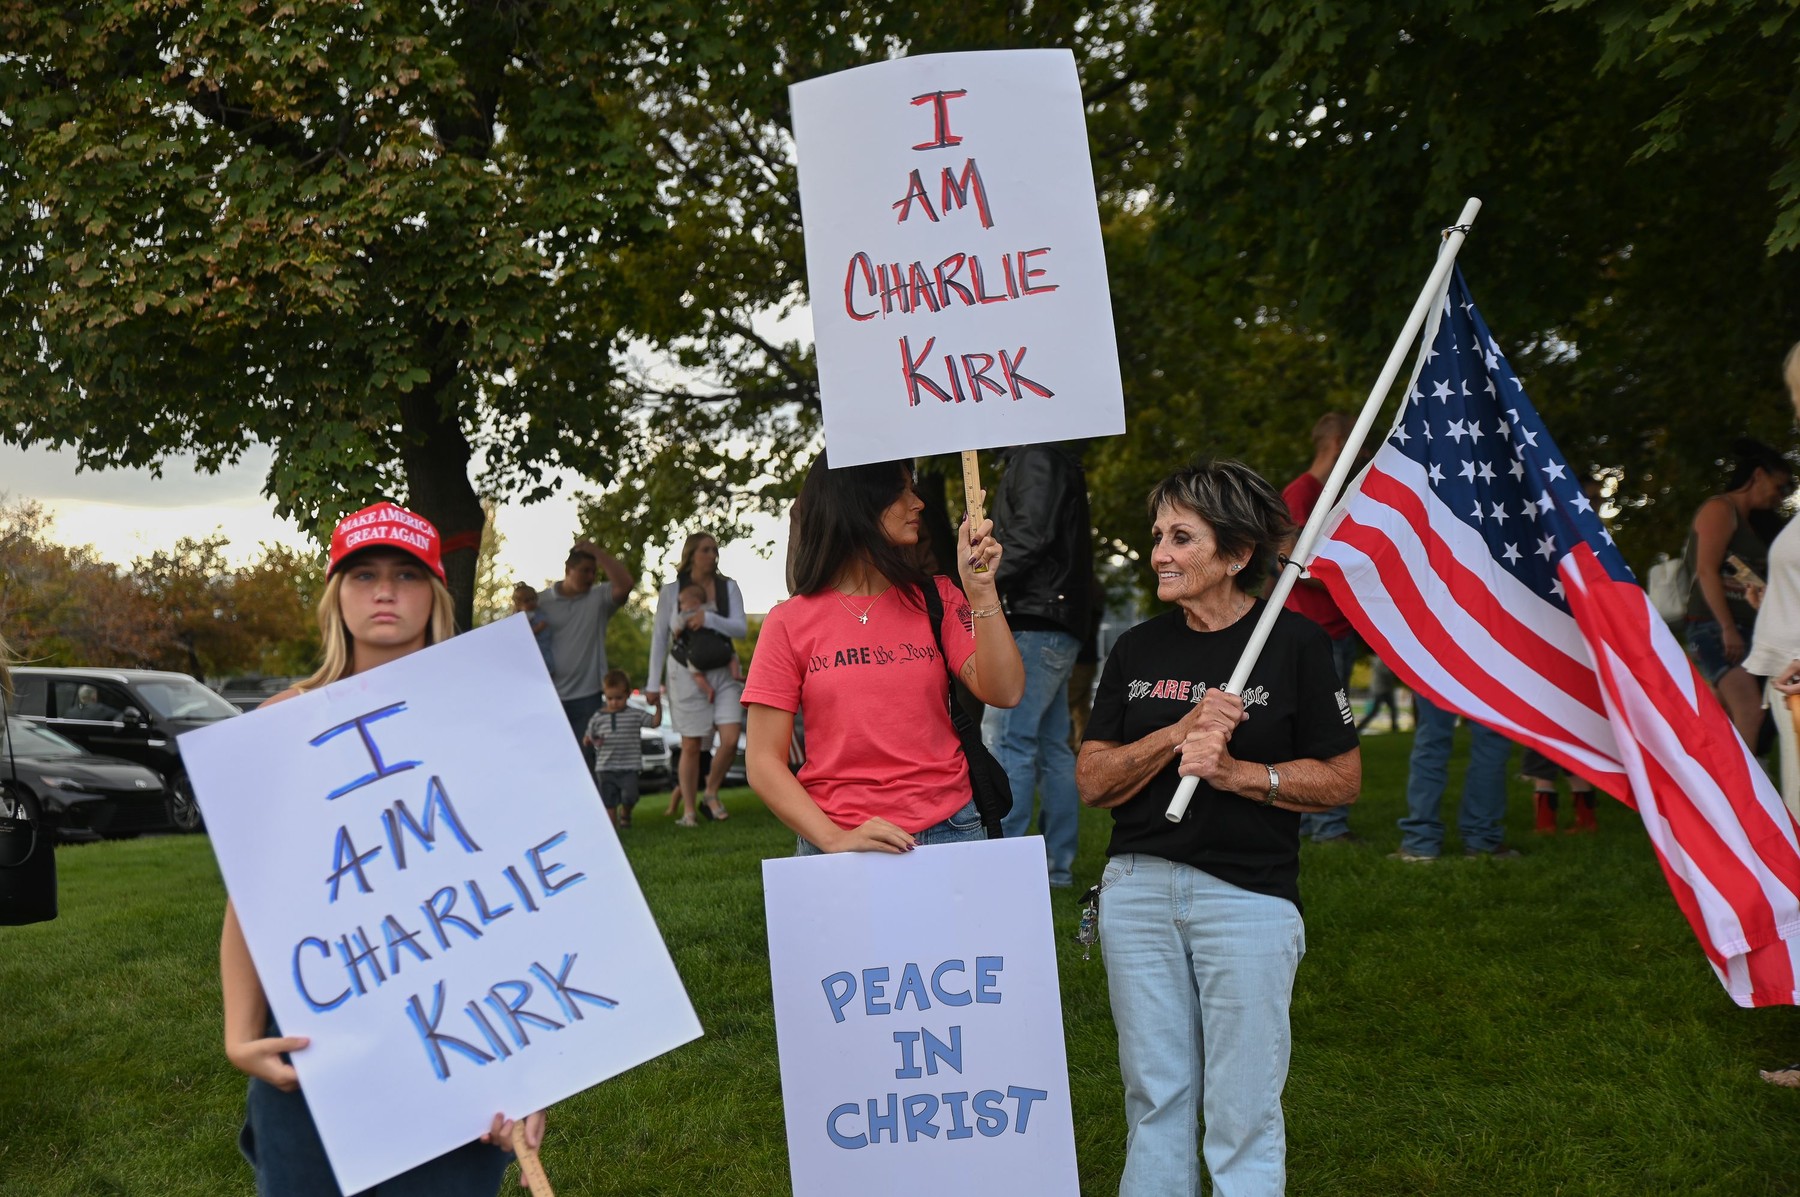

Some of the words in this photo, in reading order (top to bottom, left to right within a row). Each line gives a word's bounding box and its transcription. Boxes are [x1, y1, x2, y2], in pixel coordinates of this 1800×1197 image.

[910, 88, 968, 151] I
[892, 158, 994, 230] AM
[845, 247, 1060, 321] CHARLIE
[899, 335, 1055, 406] KIRK
[340, 511, 377, 535] MAKE
[378, 508, 436, 538] AMERICA
[346, 526, 388, 548] GREAT
[389, 527, 430, 551] AGAIN
[808, 655, 832, 674] We
[834, 647, 871, 667] ARE
[1150, 680, 1191, 700] ARE
[1190, 681, 1208, 703] th
[308, 700, 424, 800] I
[325, 775, 482, 904] AM
[292, 830, 587, 1014] CHARLIE
[405, 952, 619, 1081] KIRK
[821, 956, 1004, 1023] PEACE
[893, 1025, 962, 1079] IN
[826, 1085, 1048, 1150] CHRIST
